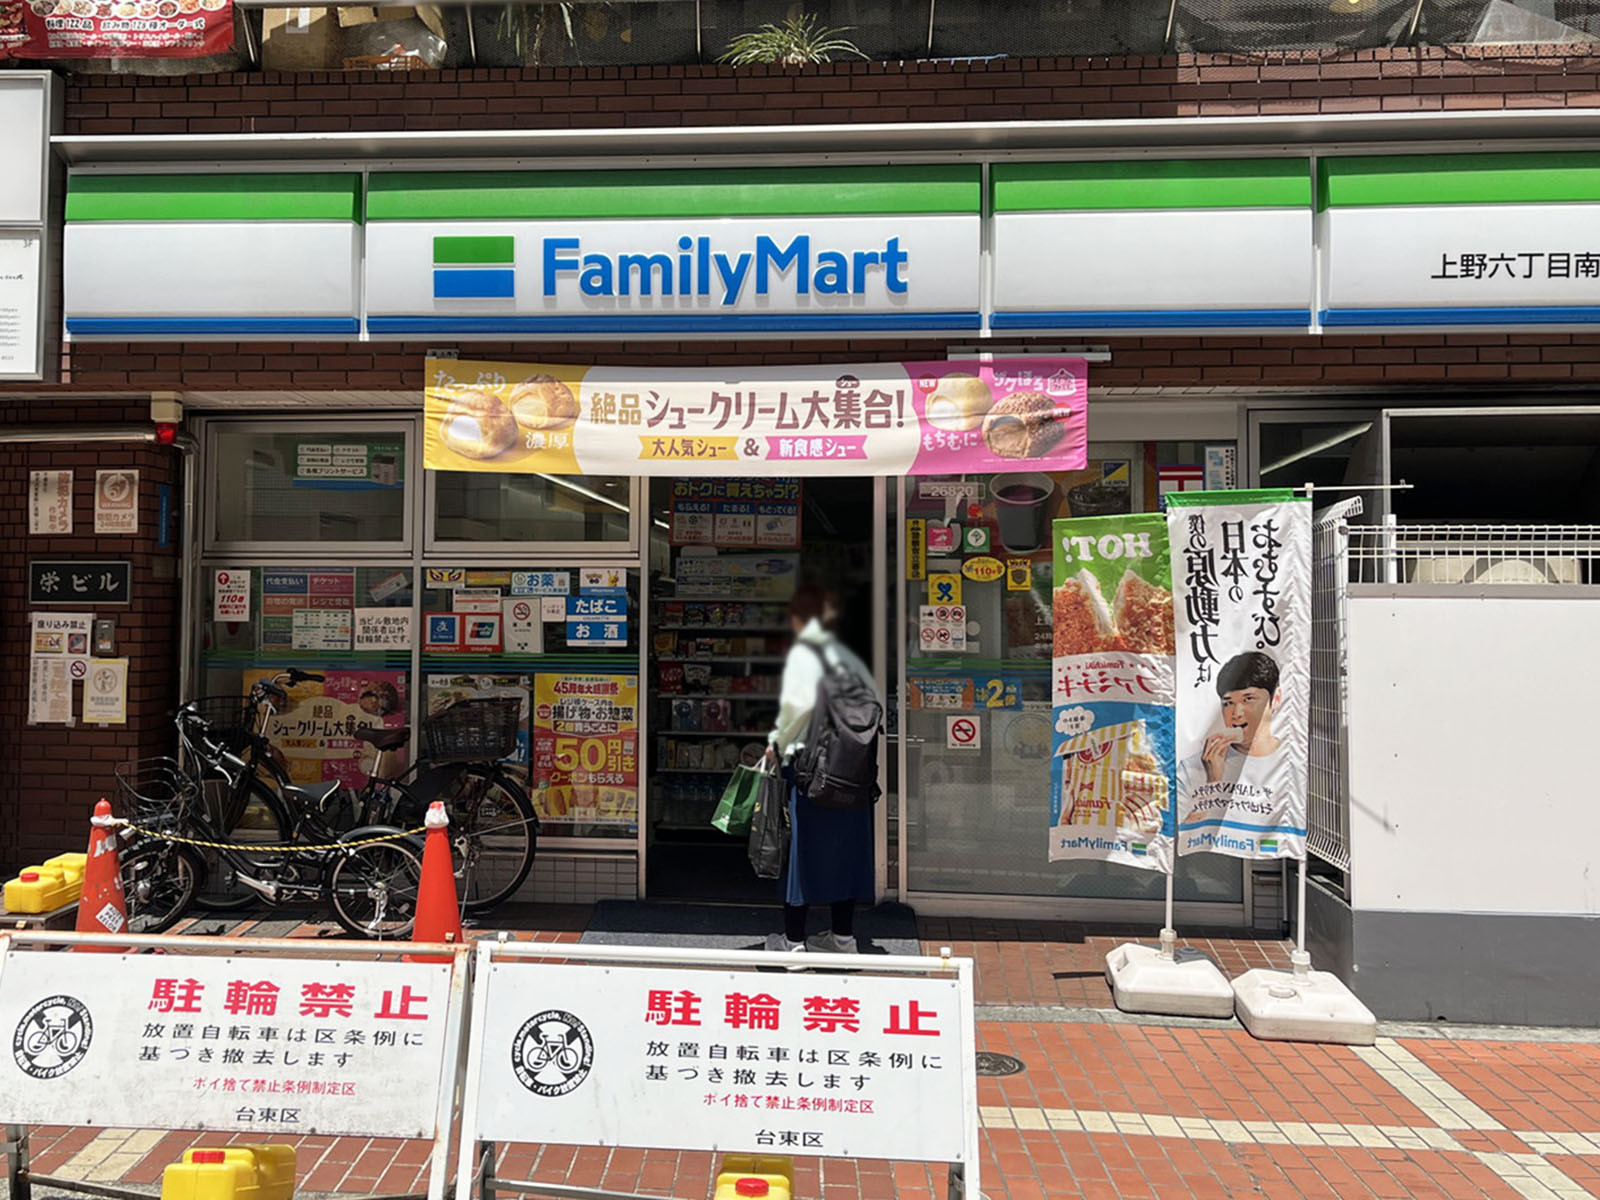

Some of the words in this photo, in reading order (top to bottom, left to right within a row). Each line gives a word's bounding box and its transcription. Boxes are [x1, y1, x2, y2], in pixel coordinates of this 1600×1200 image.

[542, 235, 908, 305] FamilyMart
[1431, 252, 1600, 279] 上野六丁目南
[433, 369, 507, 393] たっぷり
[919, 379, 936, 388] NEW
[525, 431, 570, 449] 濃厚
[652, 438, 727, 457] 大人気シュー
[743, 438, 760, 457] &
[779, 438, 857, 458] 新食感シュー
[923, 431, 978, 451] もちむに
[931, 485, 974, 497] 26820
[39, 570, 120, 594] 栄ビル
[526, 573, 555, 587] お薬
[575, 599, 618, 613] たばこ
[362, 626, 405, 635] 関係者以外
[575, 624, 619, 638] お酒
[312, 705, 333, 719] 絶品
[147, 977, 430, 1021] 駐輪禁止
[644, 988, 943, 1037] 駐輪禁止
[142, 1022, 425, 1047] 放置自転車は区条例に
[138, 1045, 354, 1068] 基づき撤去します
[645, 1040, 943, 1071] 放置自転車は区条例に
[644, 1063, 873, 1092] 基づき撤去します
[702, 1092, 875, 1115] ポイ捨て禁止条例制定区
[235, 1106, 302, 1124] 台東区
[754, 1128, 825, 1149] 台東区
